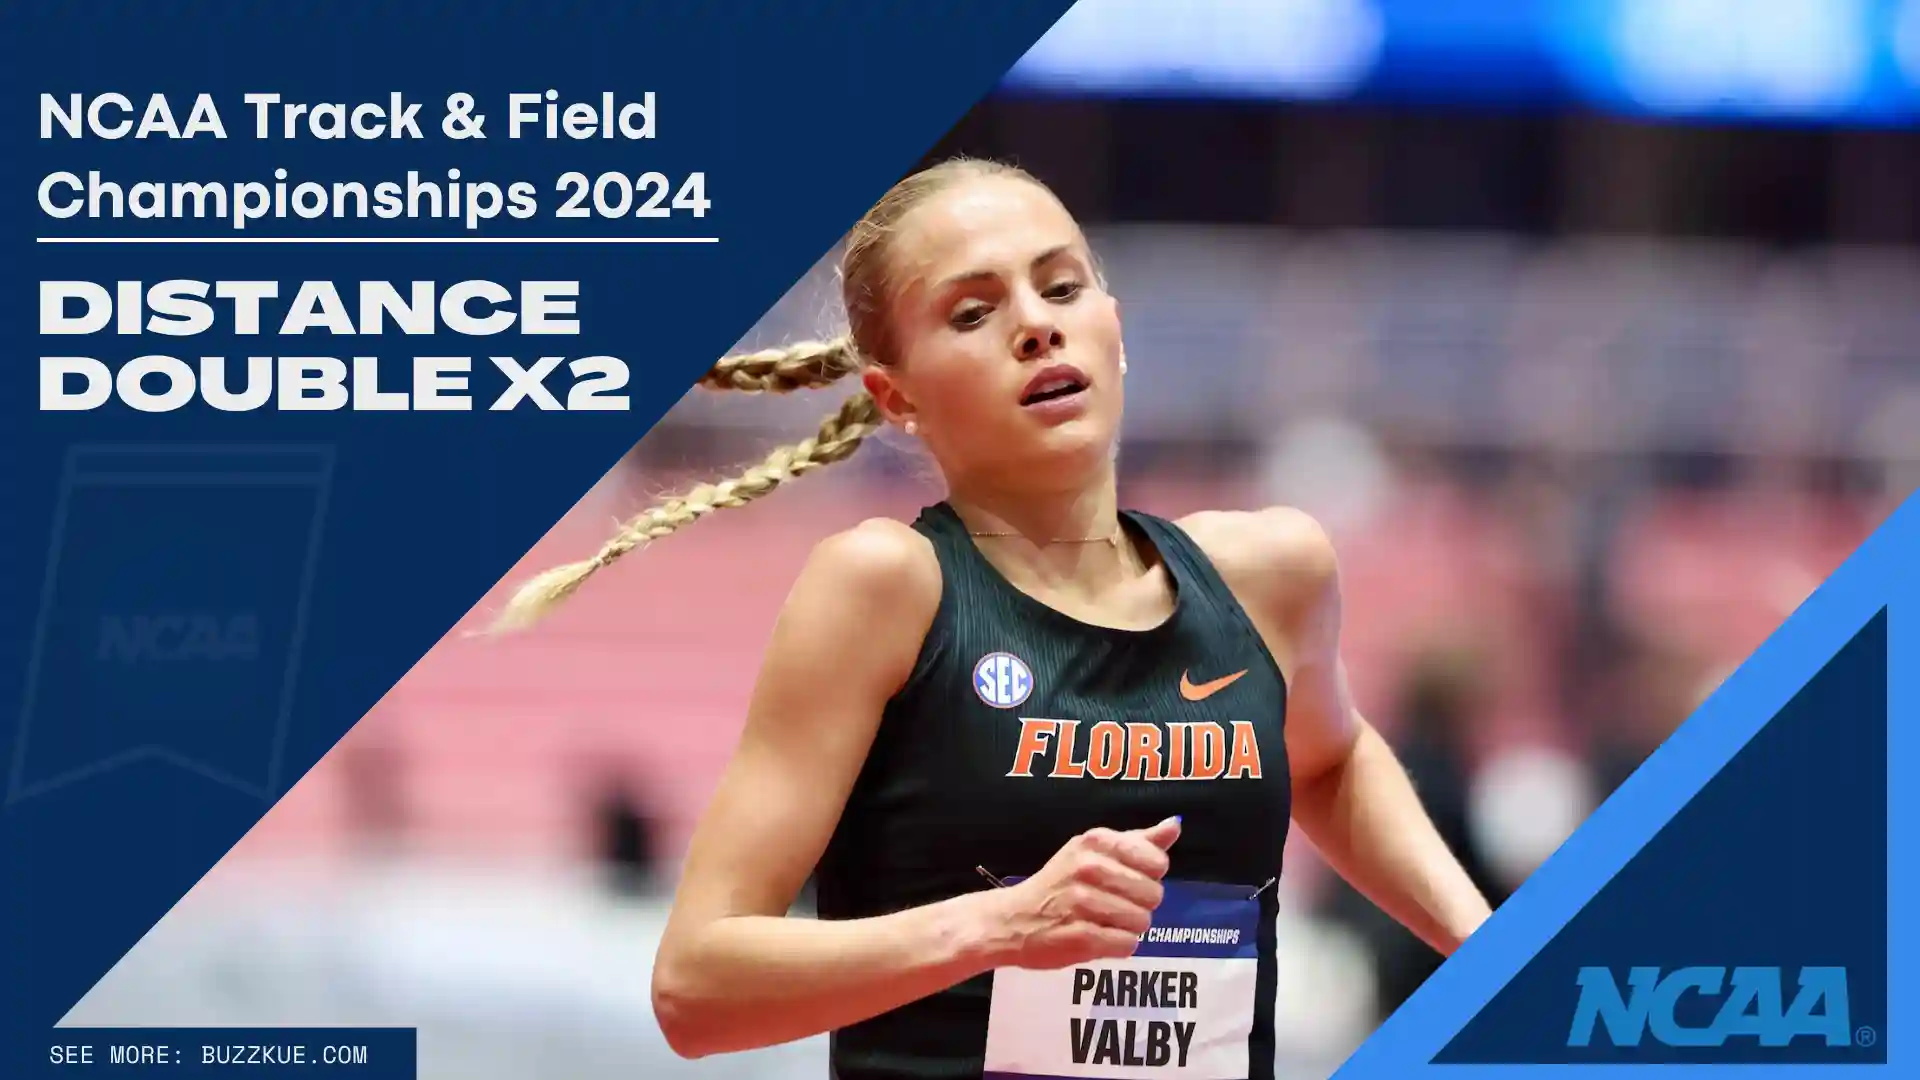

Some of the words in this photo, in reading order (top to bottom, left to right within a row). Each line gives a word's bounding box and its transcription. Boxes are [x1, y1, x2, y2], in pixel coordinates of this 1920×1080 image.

[978, 655, 1028, 704] SEC
[1005, 716, 1262, 780] FLORIDA
[1147, 927, 1241, 945] CHAMPIONSHIPS
[1071, 968, 1198, 1009] PARKER
[1069, 1017, 1197, 1067] VALBY
